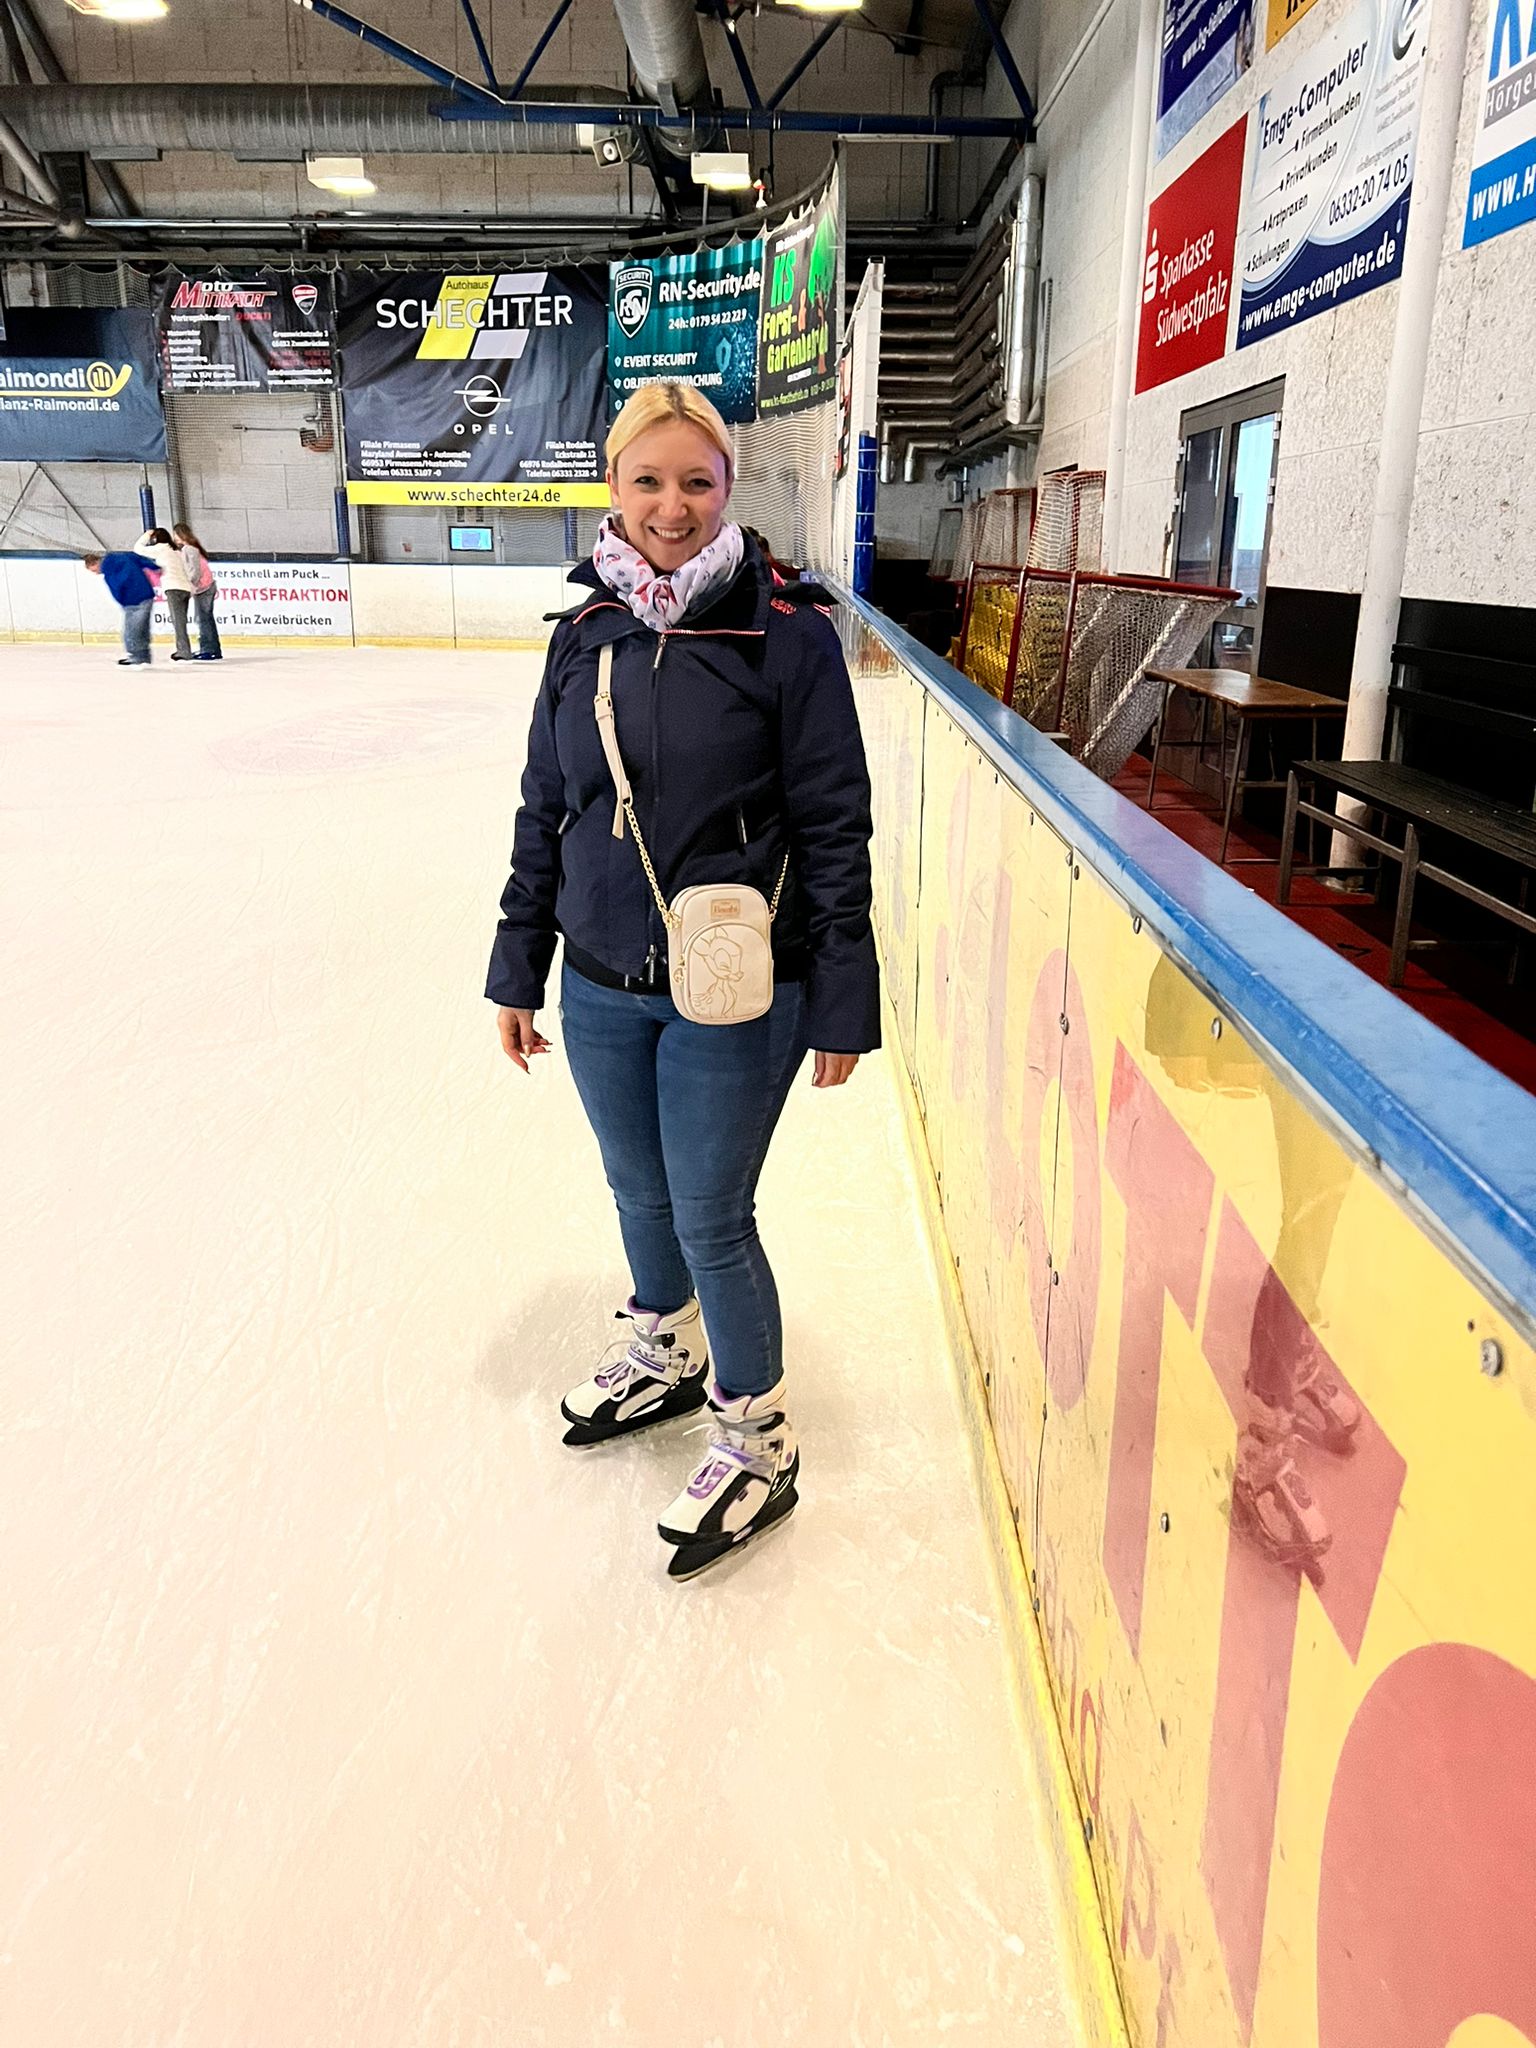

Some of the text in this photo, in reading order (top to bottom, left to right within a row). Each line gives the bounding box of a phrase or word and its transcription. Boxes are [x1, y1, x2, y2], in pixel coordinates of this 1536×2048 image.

[1261, 40, 1368, 150] Emge-Computer
[1301, 91, 1361, 150] Firmenkunden
[1283, 140, 1338, 191] Privatkunden
[1376, 164, 1392, 200] 74
[1393, 153, 1409, 188] 05
[1160, 229, 1214, 300] Sparkasse
[1251, 238, 1290, 272] Schulungen
[446, 279, 490, 291] Autohaus
[658, 266, 761, 303] RN-Security.de
[1245, 230, 1396, 332] www.emge-computer.de
[375, 294, 574, 329] SCHECHTER
[668, 317, 689, 330] 24h:
[1155, 269, 1228, 347] Südwestpfalz
[652, 352, 698, 367] SECURITY
[453, 423, 514, 436] OPEL
[407, 488, 562, 504] www.schechter24.de
[230, 569, 271, 579] schnell
[273, 571, 290, 579] am
[292, 569, 320, 579] Puck
[214, 588, 349, 602] TRATSFRAKTION
[254, 613, 332, 625] Zweibrücken
